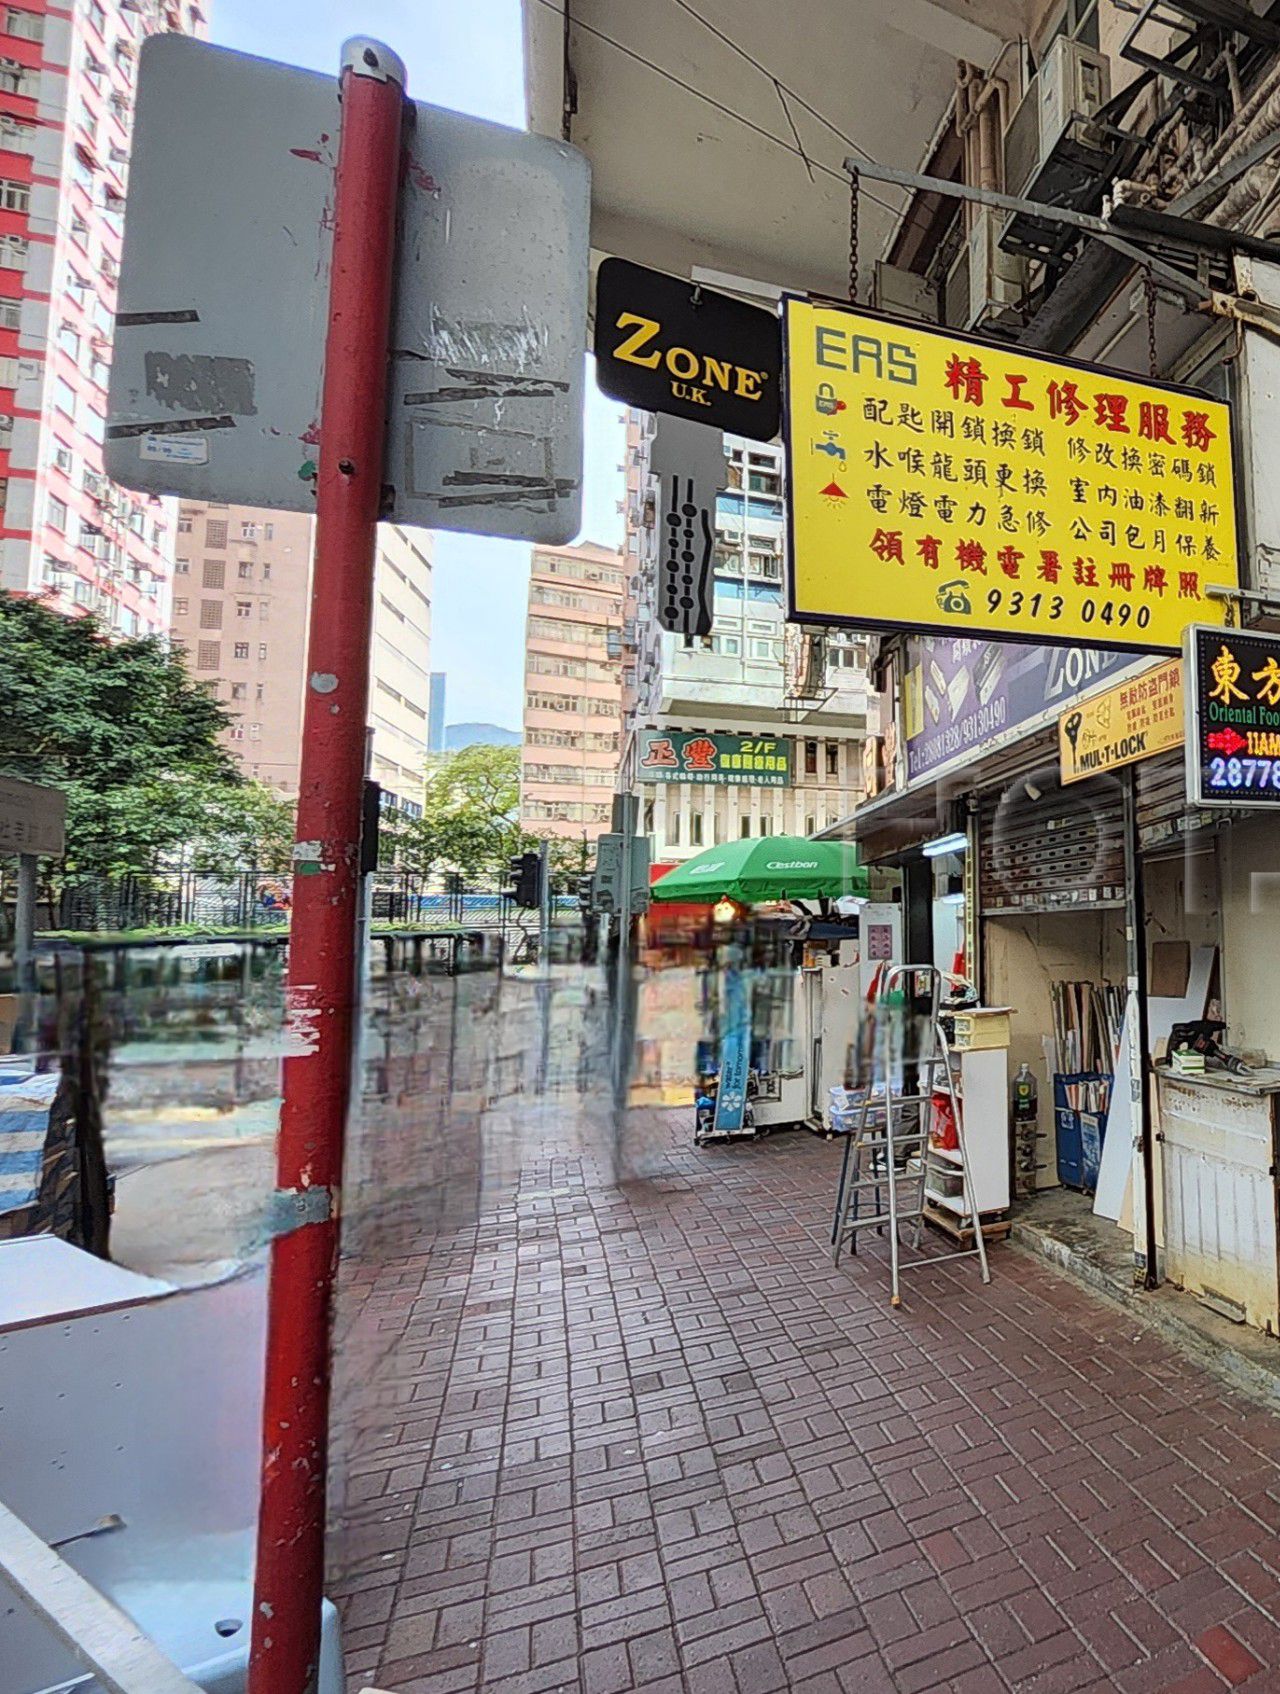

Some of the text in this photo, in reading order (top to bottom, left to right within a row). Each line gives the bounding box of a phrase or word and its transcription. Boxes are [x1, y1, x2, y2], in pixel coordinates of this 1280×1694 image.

[612, 311, 768, 402] ZONE
[815, 325, 918, 387] ERS
[669, 380, 713, 407] U.K.
[943, 352, 1218, 453] 精工修理服務
[862, 397, 1218, 489] 配匙開鎖換鎖 修改換密碼鎖
[863, 440, 1049, 498] 水喉龍頭更換
[866, 483, 1222, 562] 電燈電力急修 公司包月保養
[868, 527, 1204, 602] 領有機電署註冊牌照
[986, 588, 1151, 629] 9313 0490
[1209, 702, 1256, 725] Oriental
[739, 740, 777, 754] 2/F
